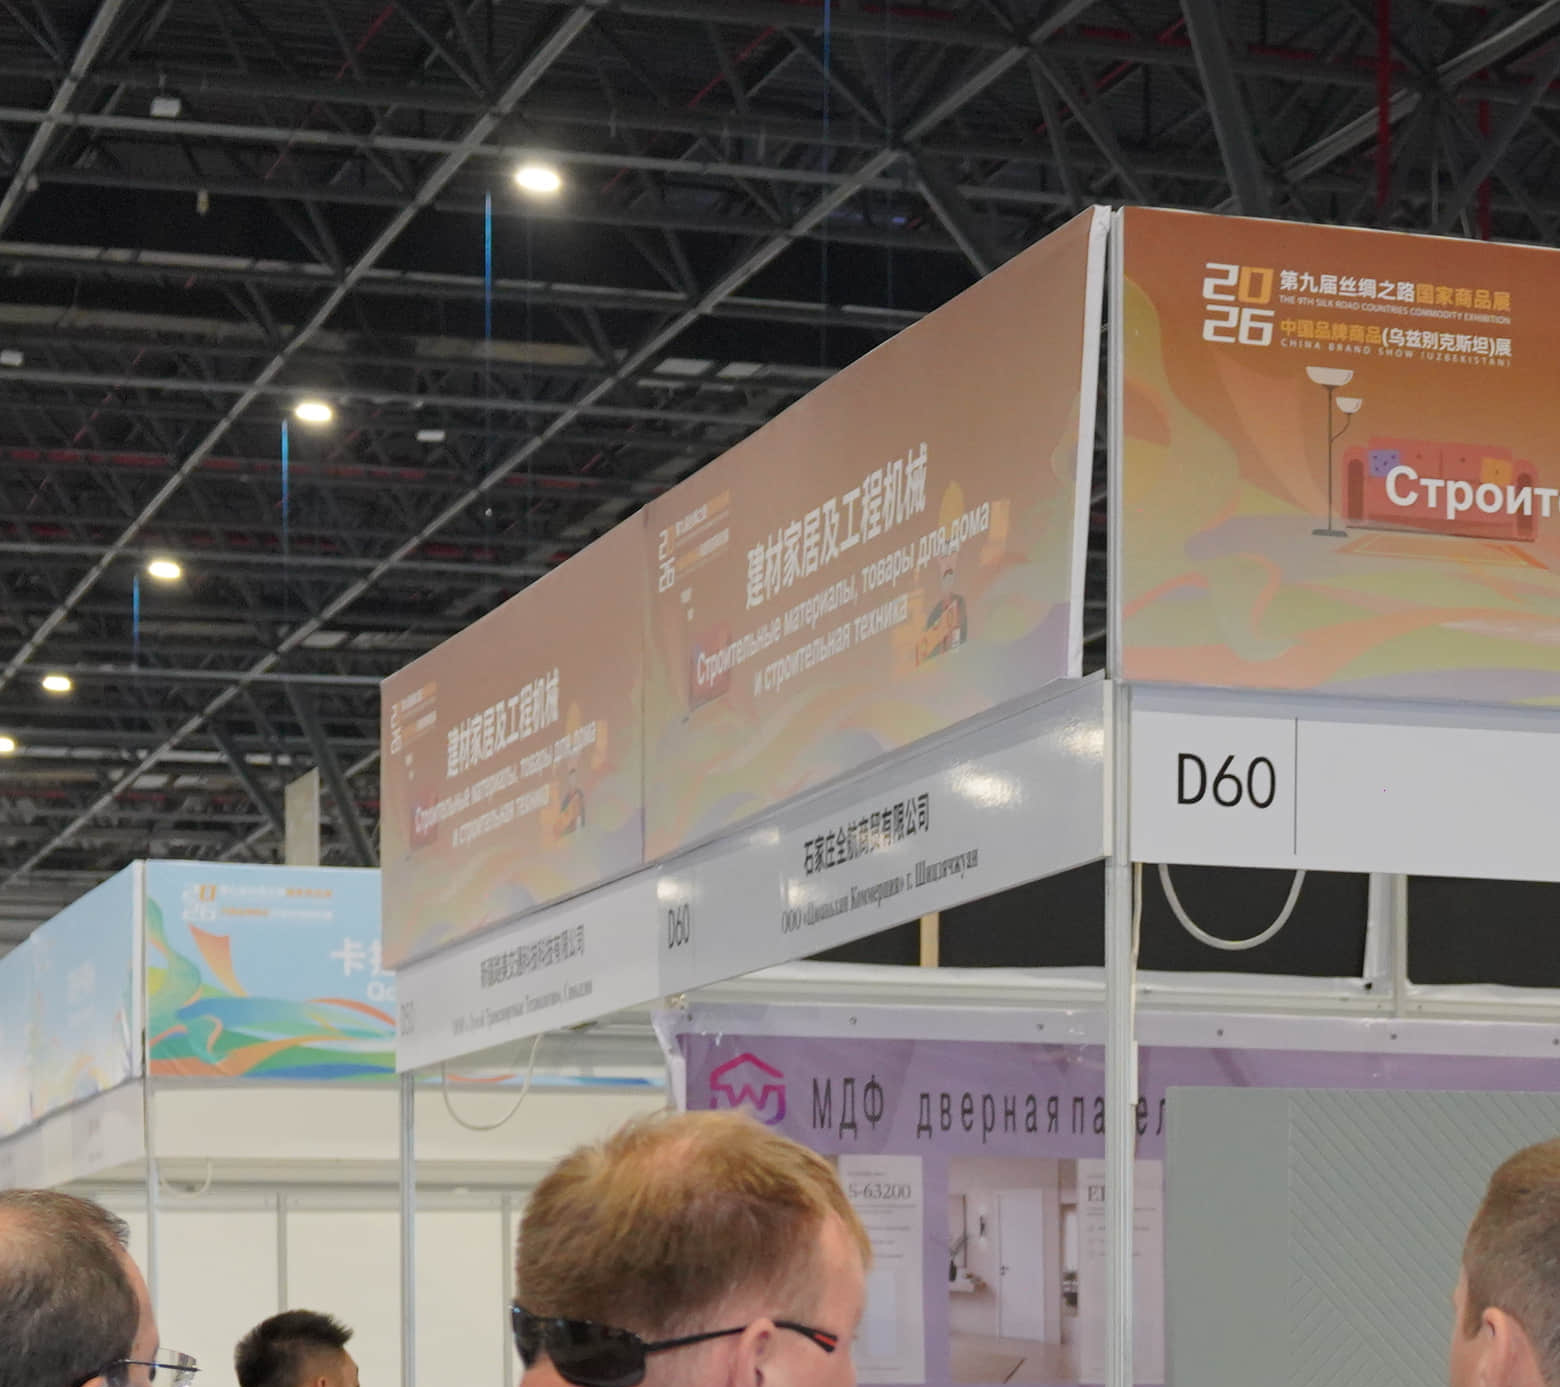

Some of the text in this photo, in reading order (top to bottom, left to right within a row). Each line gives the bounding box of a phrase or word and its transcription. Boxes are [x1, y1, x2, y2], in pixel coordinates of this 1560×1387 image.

[697, 617, 781, 687] Строительные
[861, 543, 915, 593] товары
[947, 502, 990, 551] дома
[764, 628, 850, 693] строительная
[854, 594, 909, 645] техника
[1178, 753, 1276, 808] D60
[668, 903, 690, 949] D60
[812, 1074, 886, 1139] МДФ
[916, 1089, 1059, 1145] дверная
